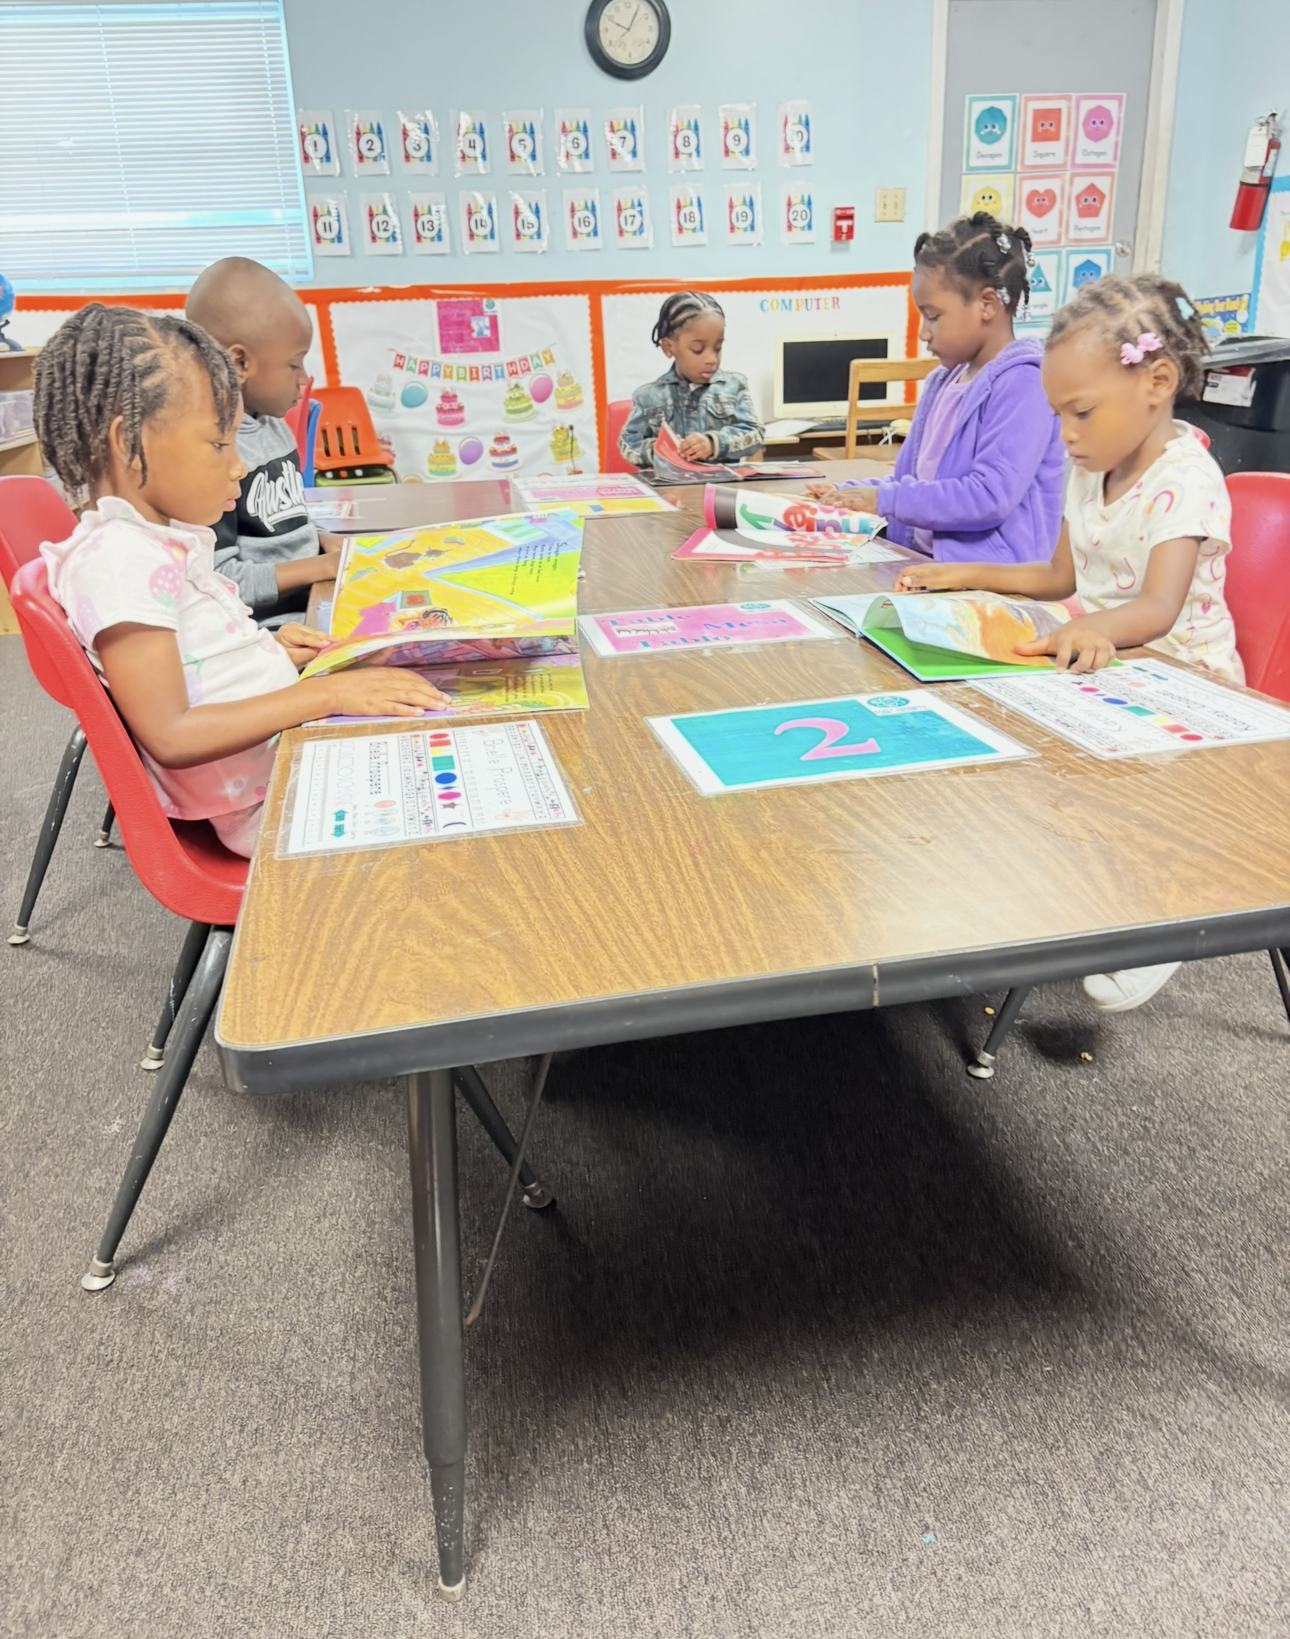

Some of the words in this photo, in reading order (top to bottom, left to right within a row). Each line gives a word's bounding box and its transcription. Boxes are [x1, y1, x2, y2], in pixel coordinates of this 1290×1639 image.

[366, 139, 376, 151] 2
[468, 138, 476, 149] 4
[517, 138, 527, 150] 5
[571, 136, 580, 149] 6
[618, 136, 627, 148] 7
[682, 136, 691, 148] 8
[732, 133, 741, 146] 9
[577, 215, 591, 228] 16
[623, 213, 637, 227] 17
[683, 211, 696, 224] 18
[735, 210, 749, 223] 19
[791, 209, 808, 222] 20
[322, 221, 333, 233] 11
[375, 220, 390, 232] 12
[421, 219, 435, 232] 13
[474, 217, 487, 231] 14
[520, 218, 535, 231] 15
[759, 296, 840, 312] COMPUTER
[394, 354, 451, 378] HAPPY
[458, 351, 554, 378] BIRTHDAY
[600, 614, 691, 628] Table
[631, 633, 732, 650] Tablo
[773, 716, 882, 762] 2
[482, 738, 509, 765] Brielle
[484, 766, 514, 806] Prospere
